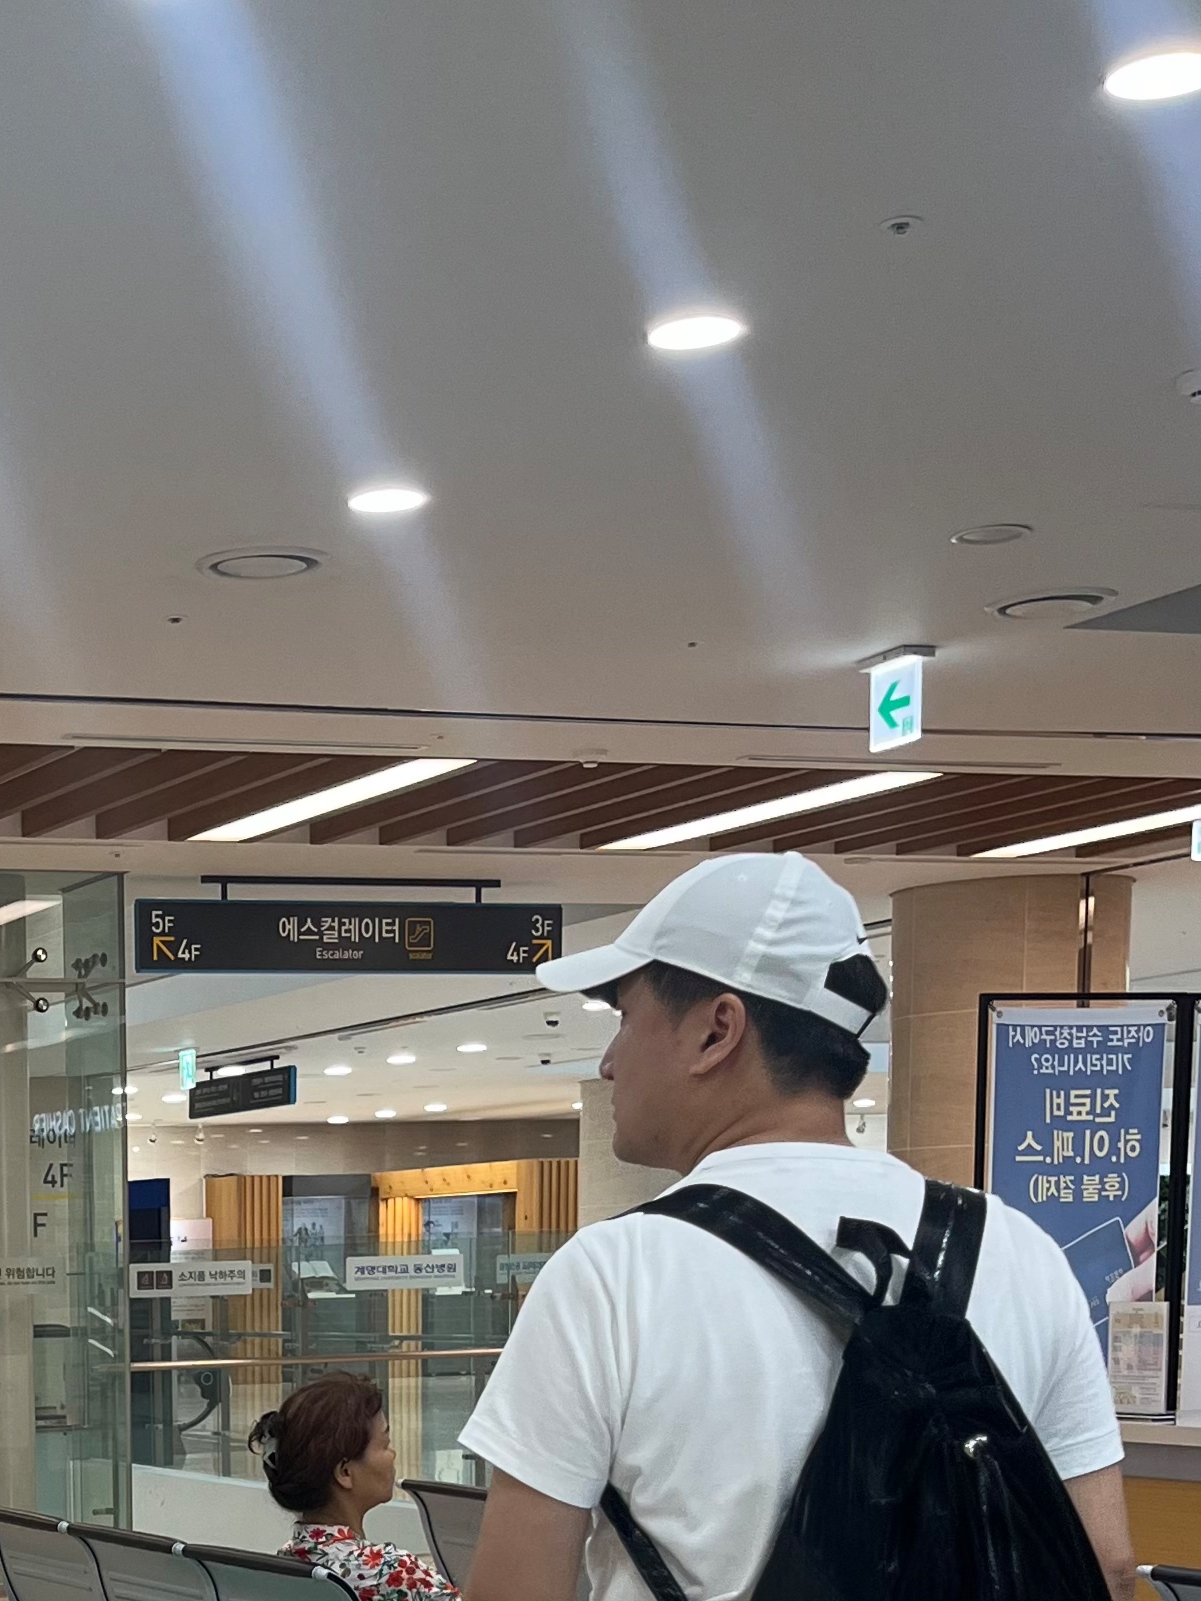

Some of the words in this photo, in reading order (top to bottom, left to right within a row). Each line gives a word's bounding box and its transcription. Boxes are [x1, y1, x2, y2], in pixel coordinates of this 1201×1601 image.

[151, 911, 174, 932] 5F
[279, 917, 398, 943] 에스컬레이터
[531, 915, 553, 936] 3F
[177, 940, 201, 961] 4F
[316, 947, 364, 960] Escalator
[507, 941, 528, 963] 4F
[43, 1163, 74, 1188] 4F
[5, 1266, 56, 1280] 위험합니다
[178, 1270, 205, 1282] 소지품
[209, 1269, 246, 1281] 낙하주의
